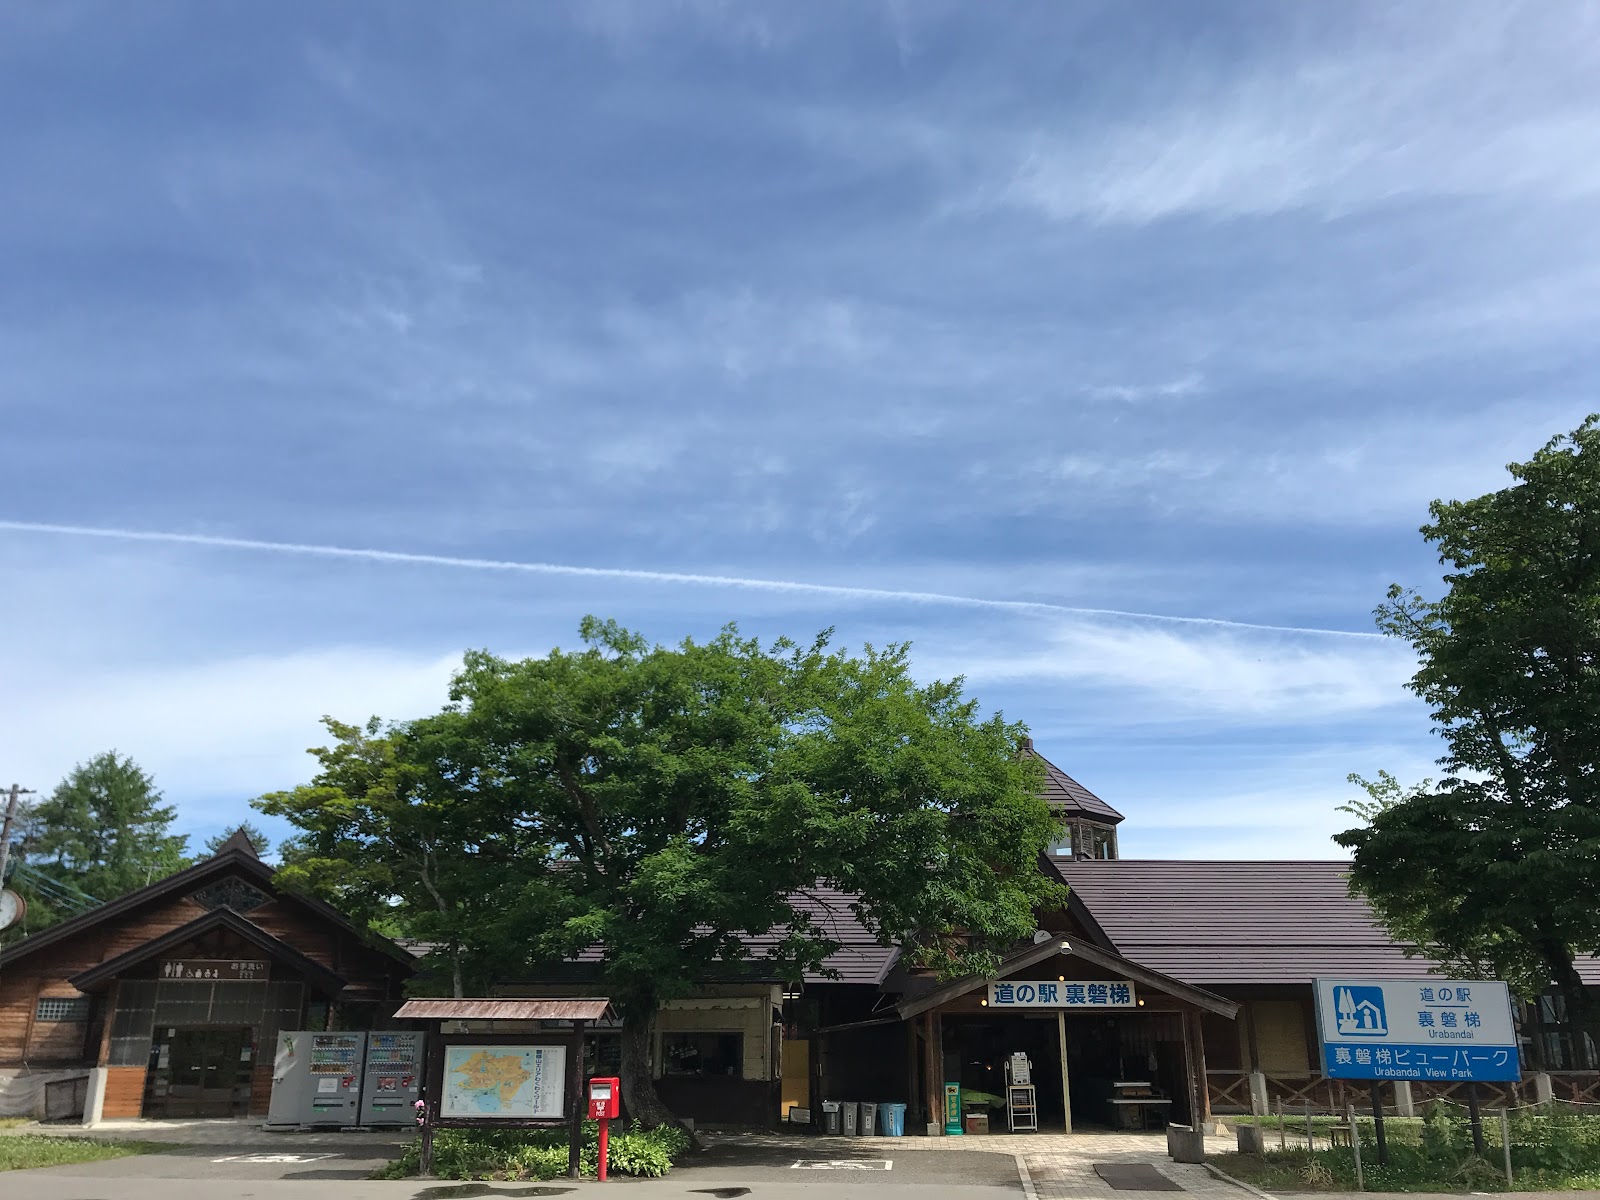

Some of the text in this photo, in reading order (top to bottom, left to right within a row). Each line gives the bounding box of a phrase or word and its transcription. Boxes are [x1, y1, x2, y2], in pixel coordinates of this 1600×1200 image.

[994, 983, 1131, 1005] 道の駅 裏磐梯
[1419, 987, 1472, 1002] 道の駅
[1417, 1011, 1482, 1028] 裏磐梯
[1428, 1029, 1474, 1039] Urabandai
[1335, 1047, 1509, 1067] 裏磐梯ビューパーク
[1374, 1067, 1473, 1078] Urabandai View Park
